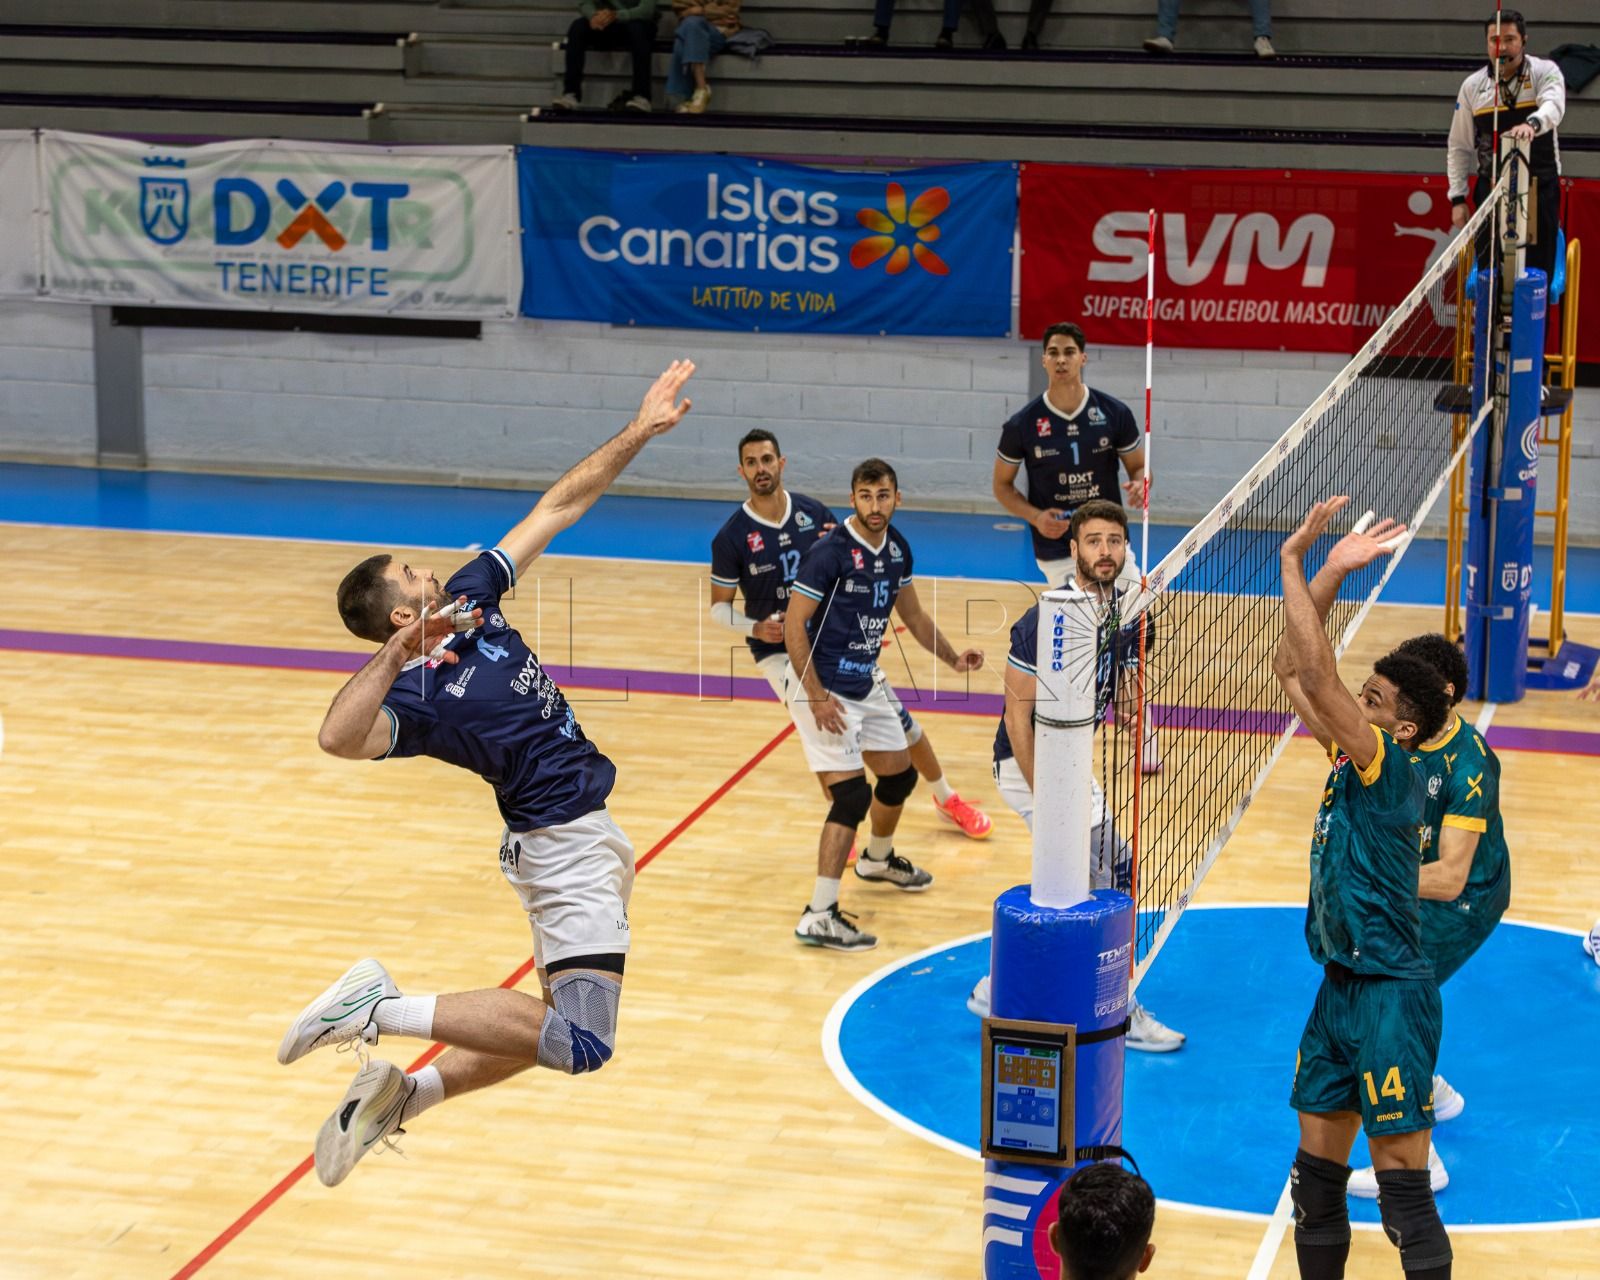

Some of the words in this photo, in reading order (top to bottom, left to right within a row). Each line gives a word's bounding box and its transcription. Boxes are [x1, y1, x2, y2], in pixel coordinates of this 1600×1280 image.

[214, 177, 410, 251] DXT
[706, 172, 839, 226] Islas
[578, 216, 840, 274] Canarias
[1087, 210, 1335, 288] SVM
[215, 262, 389, 296] TENERIFE
[770, 288, 792, 311] DE
[796, 291, 837, 313] VIDA
[1081, 294, 1185, 321] SUPERLIGA
[1191, 299, 1280, 323] VOLEIBOL
[1069, 441, 1080, 466] 1
[1068, 471, 1094, 484] DXT
[779, 549, 801, 582] 12
[873, 580, 890, 608] 15
[476, 636, 510, 663] 4
[1052, 614, 1065, 672] MONDO
[521, 652, 540, 686] DXT
[1363, 1066, 1406, 1106] 14
